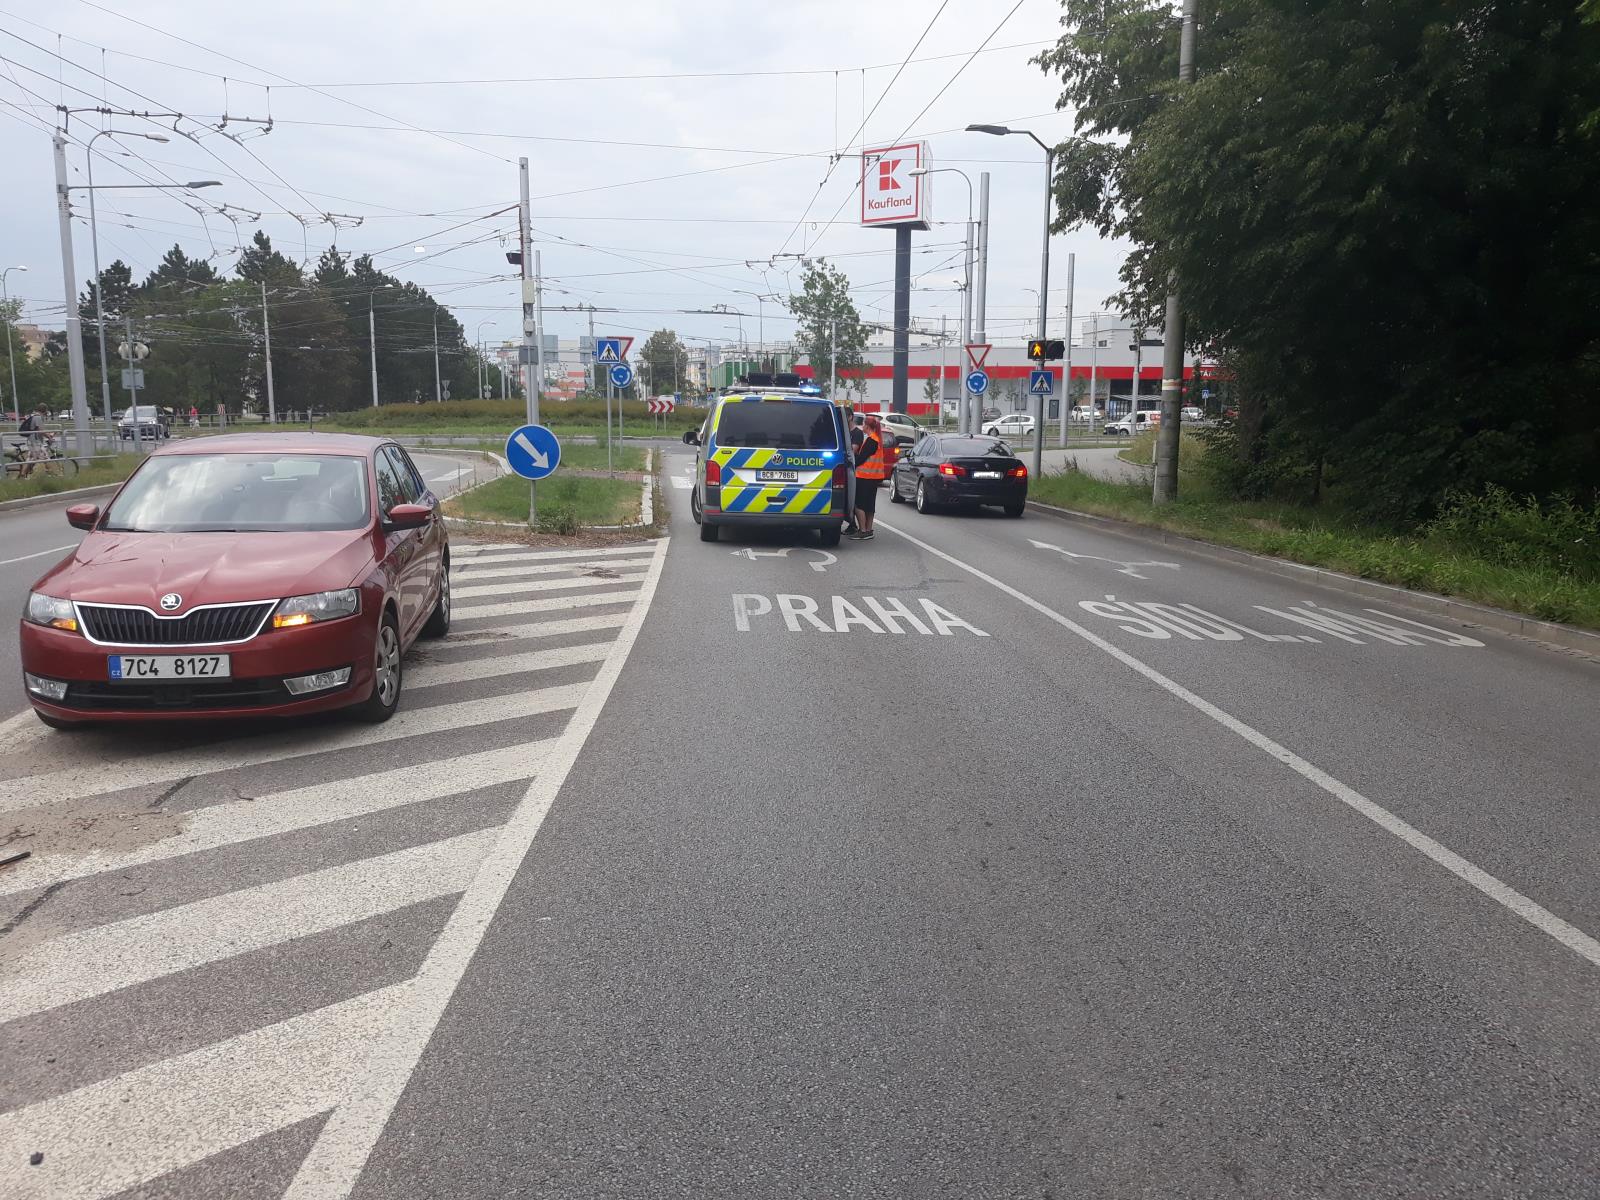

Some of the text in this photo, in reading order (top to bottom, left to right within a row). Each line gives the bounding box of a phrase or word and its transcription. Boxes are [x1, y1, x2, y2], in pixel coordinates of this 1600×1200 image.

[868, 195, 912, 209] Kaufland
[786, 457, 825, 467] POLICIE
[778, 471, 795, 479] 7866
[731, 593, 992, 637] PRAHA
[125, 657, 220, 676] 7C4 8127
